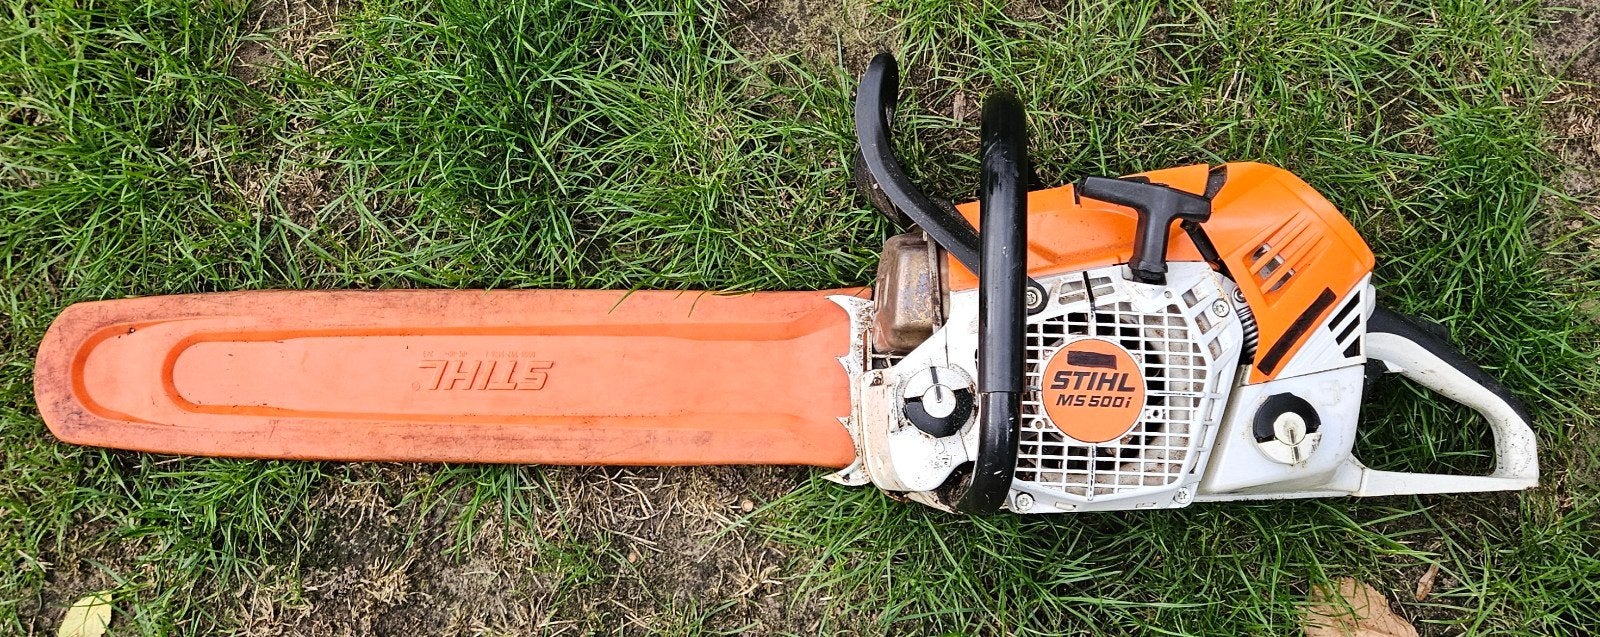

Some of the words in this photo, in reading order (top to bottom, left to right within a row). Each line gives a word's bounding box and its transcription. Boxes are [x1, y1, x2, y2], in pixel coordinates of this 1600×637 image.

[417, 360, 554, 390] STIHL
[1050, 370, 1136, 392] STIHL
[1056, 394, 1086, 406] MS
[1088, 395, 1132, 408] 500i
